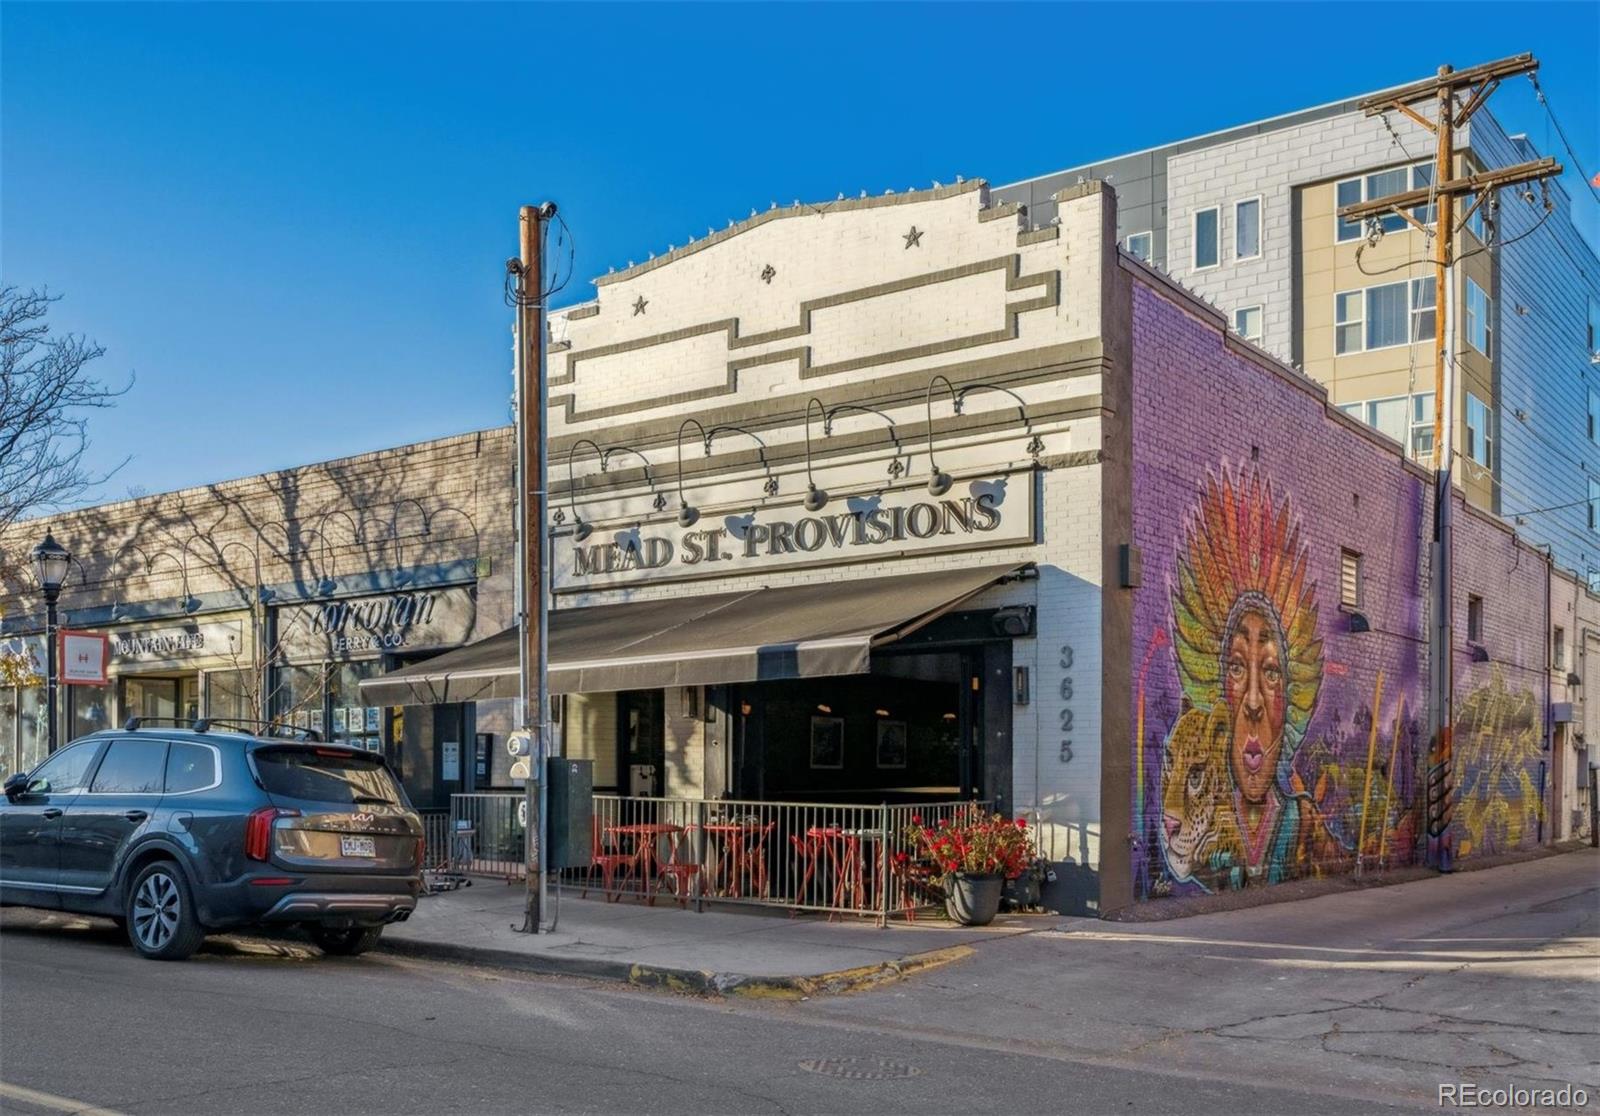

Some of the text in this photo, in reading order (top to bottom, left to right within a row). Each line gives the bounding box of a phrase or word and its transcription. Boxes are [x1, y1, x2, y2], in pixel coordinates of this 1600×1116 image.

[572, 493, 1002, 577] MEAD ST. PROVISIONS
